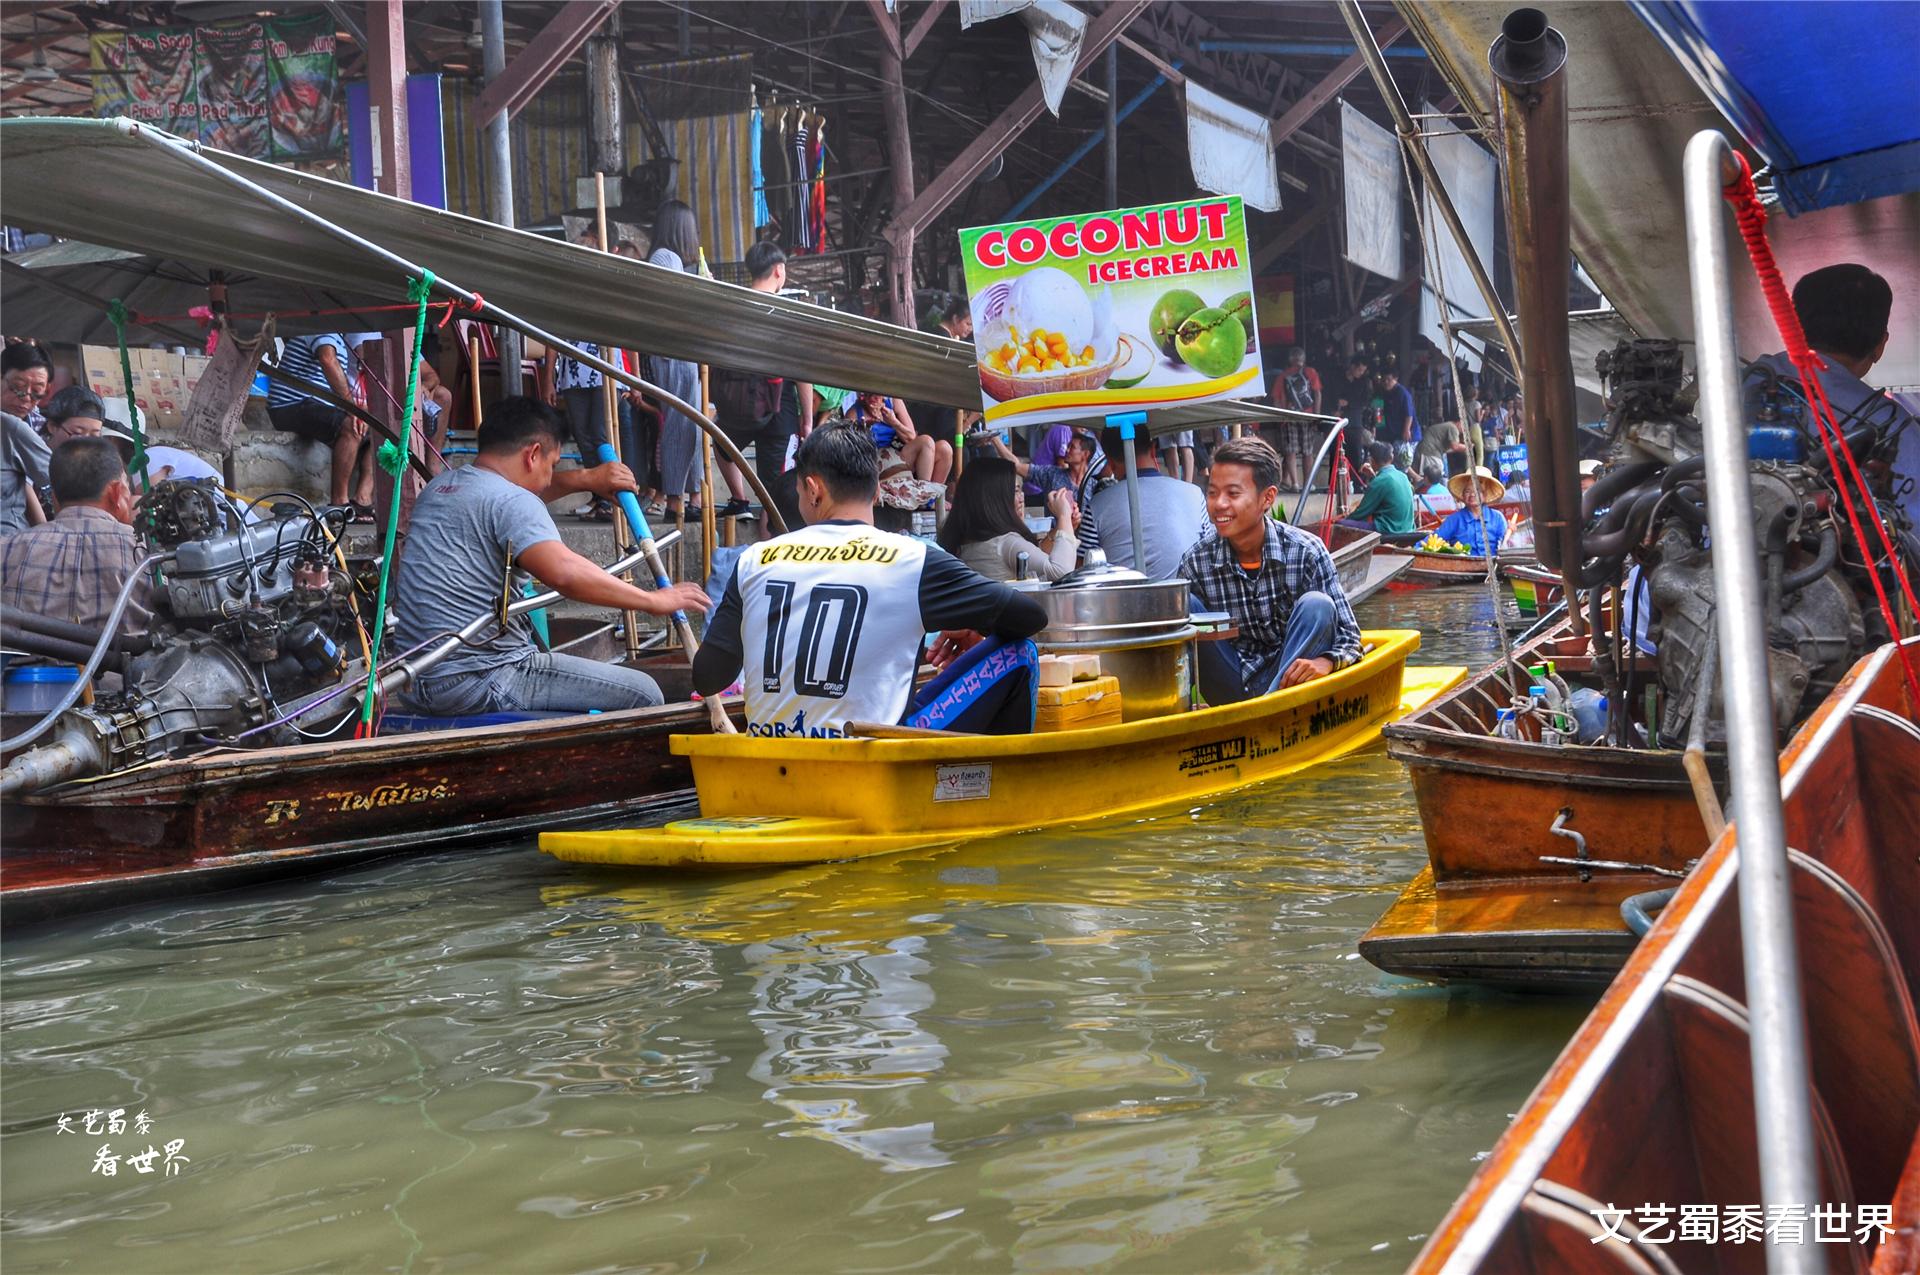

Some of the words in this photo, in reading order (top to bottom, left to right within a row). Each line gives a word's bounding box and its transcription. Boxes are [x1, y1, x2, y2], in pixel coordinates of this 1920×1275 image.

[131, 103, 162, 119] Fried
[167, 102, 196, 118] Rice
[201, 104, 228, 120] Pad
[976, 203, 1228, 268] COCONUT
[1088, 247, 1239, 284] ICECREAM
[763, 580, 869, 699] 10
